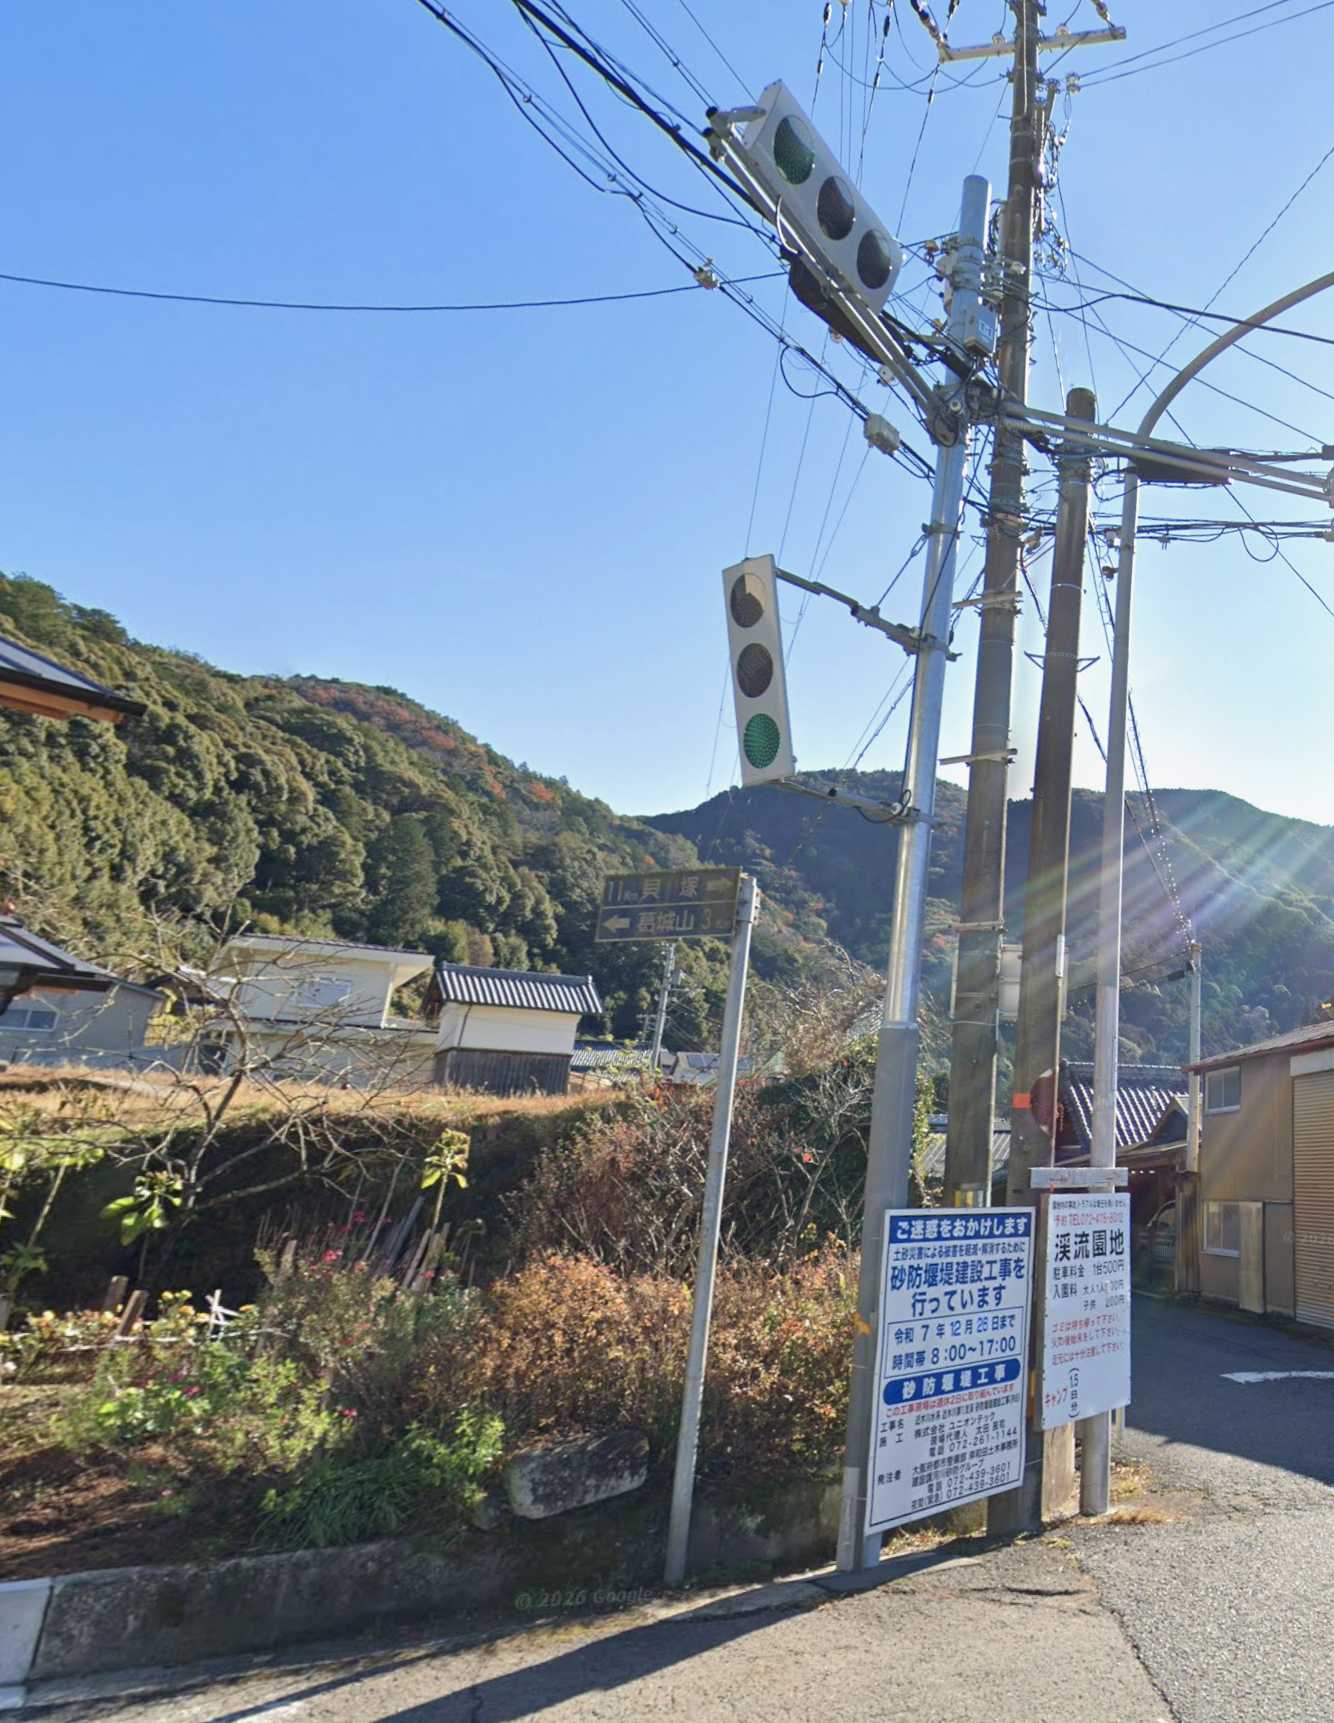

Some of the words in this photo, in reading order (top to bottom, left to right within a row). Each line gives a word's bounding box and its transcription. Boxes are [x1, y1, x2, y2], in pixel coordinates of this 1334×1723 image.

[896, 1217, 1028, 1239] ご迷惑をおかけします
[1054, 1228, 1125, 1262] 渓流園地
[890, 1257, 1025, 1292] 砂防堰堤建設工事を
[911, 1284, 1007, 1317] 行っています
[880, 1418, 904, 1433] 工事名
